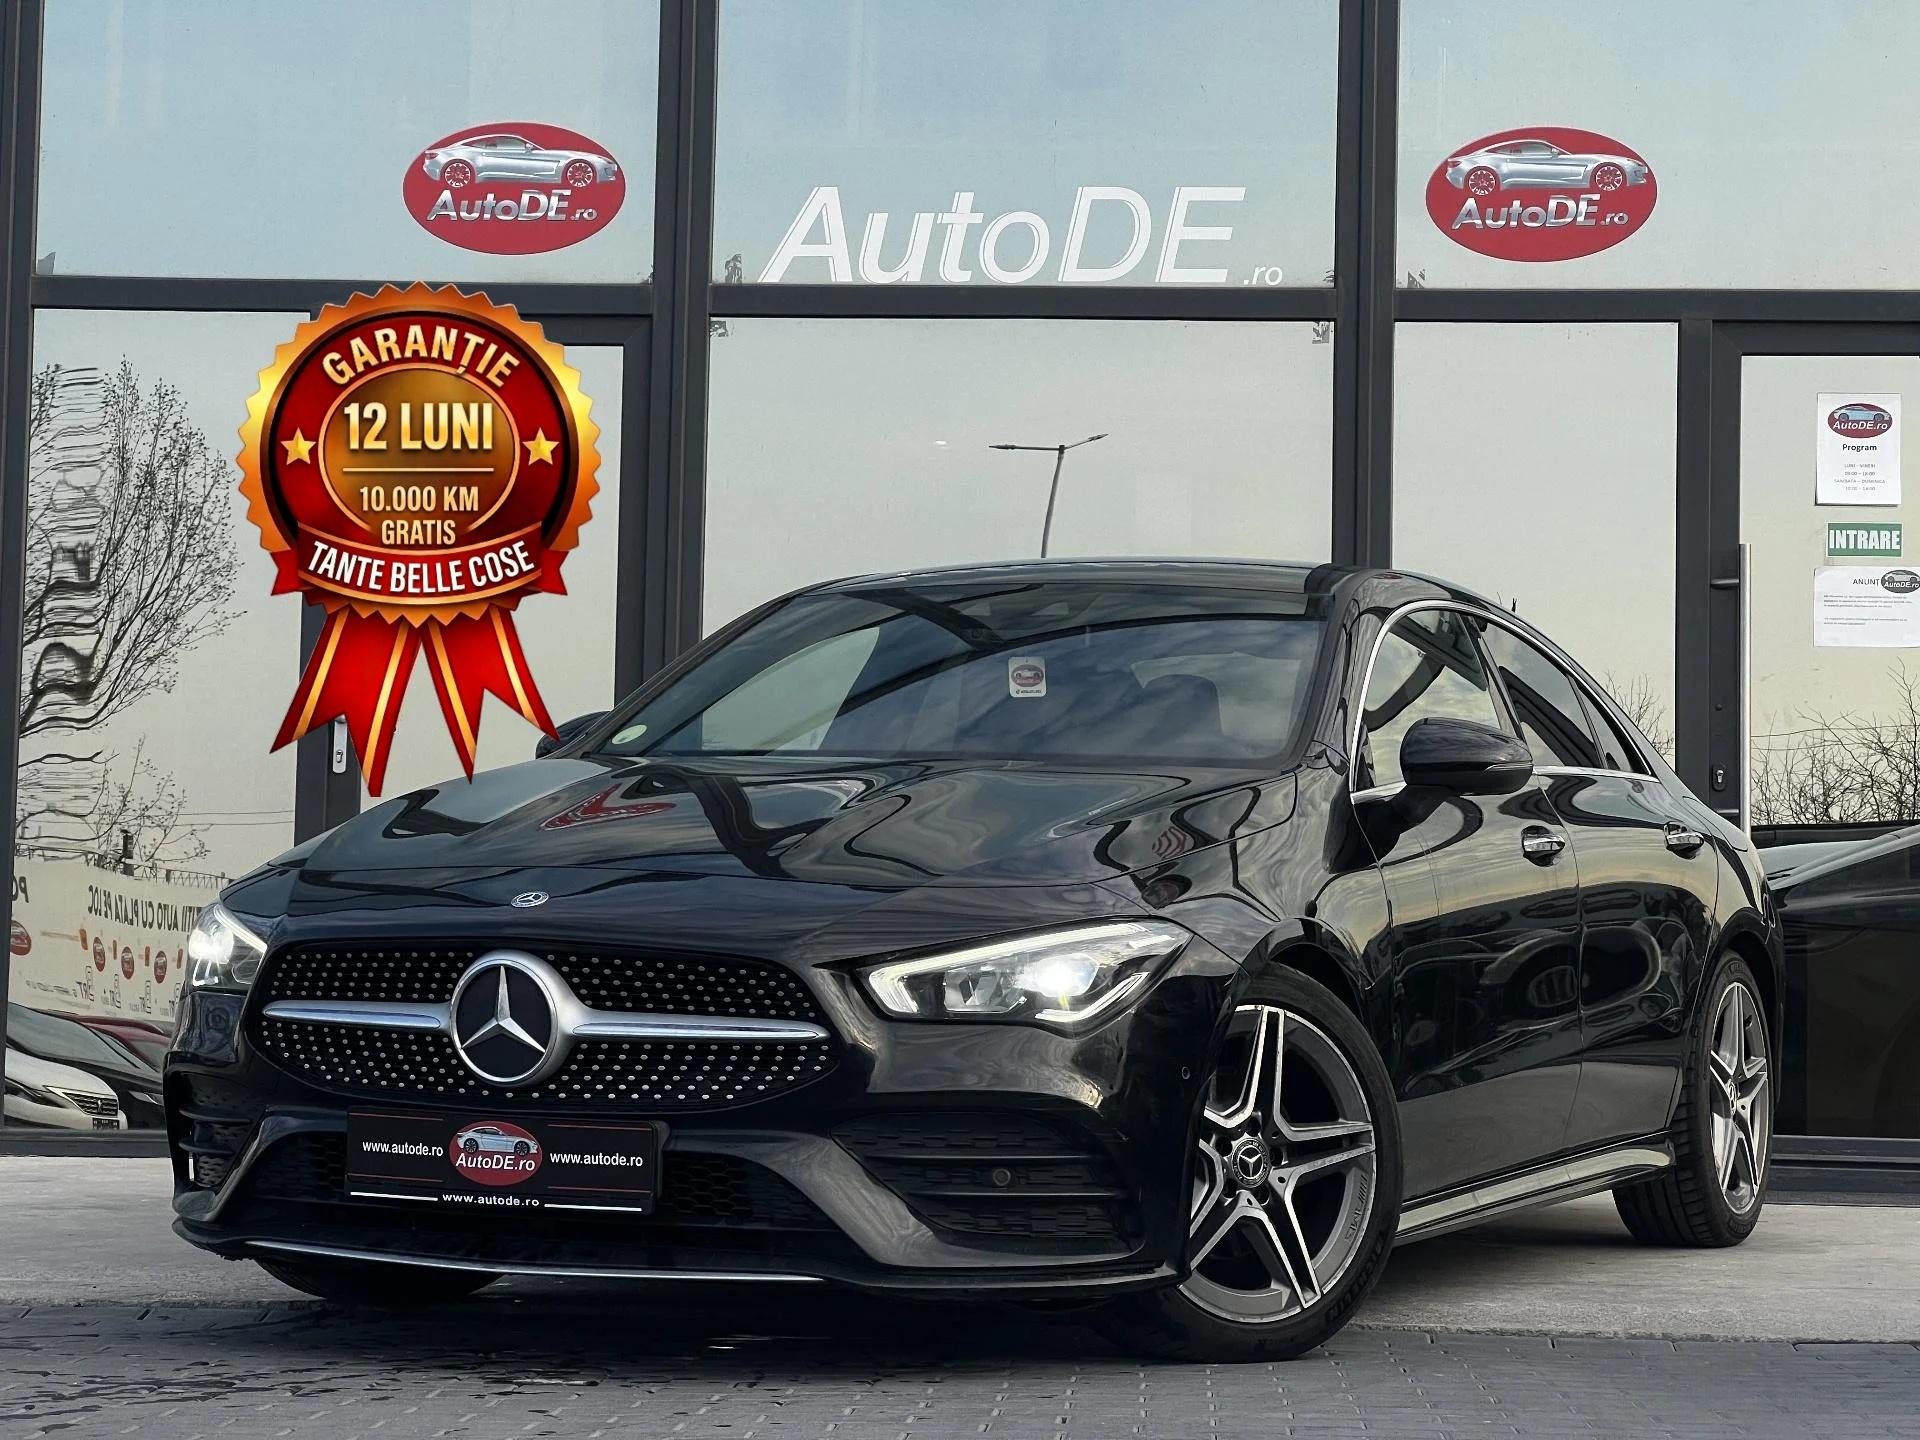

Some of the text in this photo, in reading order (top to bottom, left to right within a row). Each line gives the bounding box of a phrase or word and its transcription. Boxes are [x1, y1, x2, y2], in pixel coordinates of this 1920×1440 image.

[1833, 421, 1888, 430] AutoDE.ro
[1842, 443, 1877, 453] Program
[1829, 530, 1901, 550] INTRARE
[362, 1141, 643, 1171] www.autode.ro AutoDE.ro www.autode.ro
[442, 1193, 540, 1207] www.autode.ro
